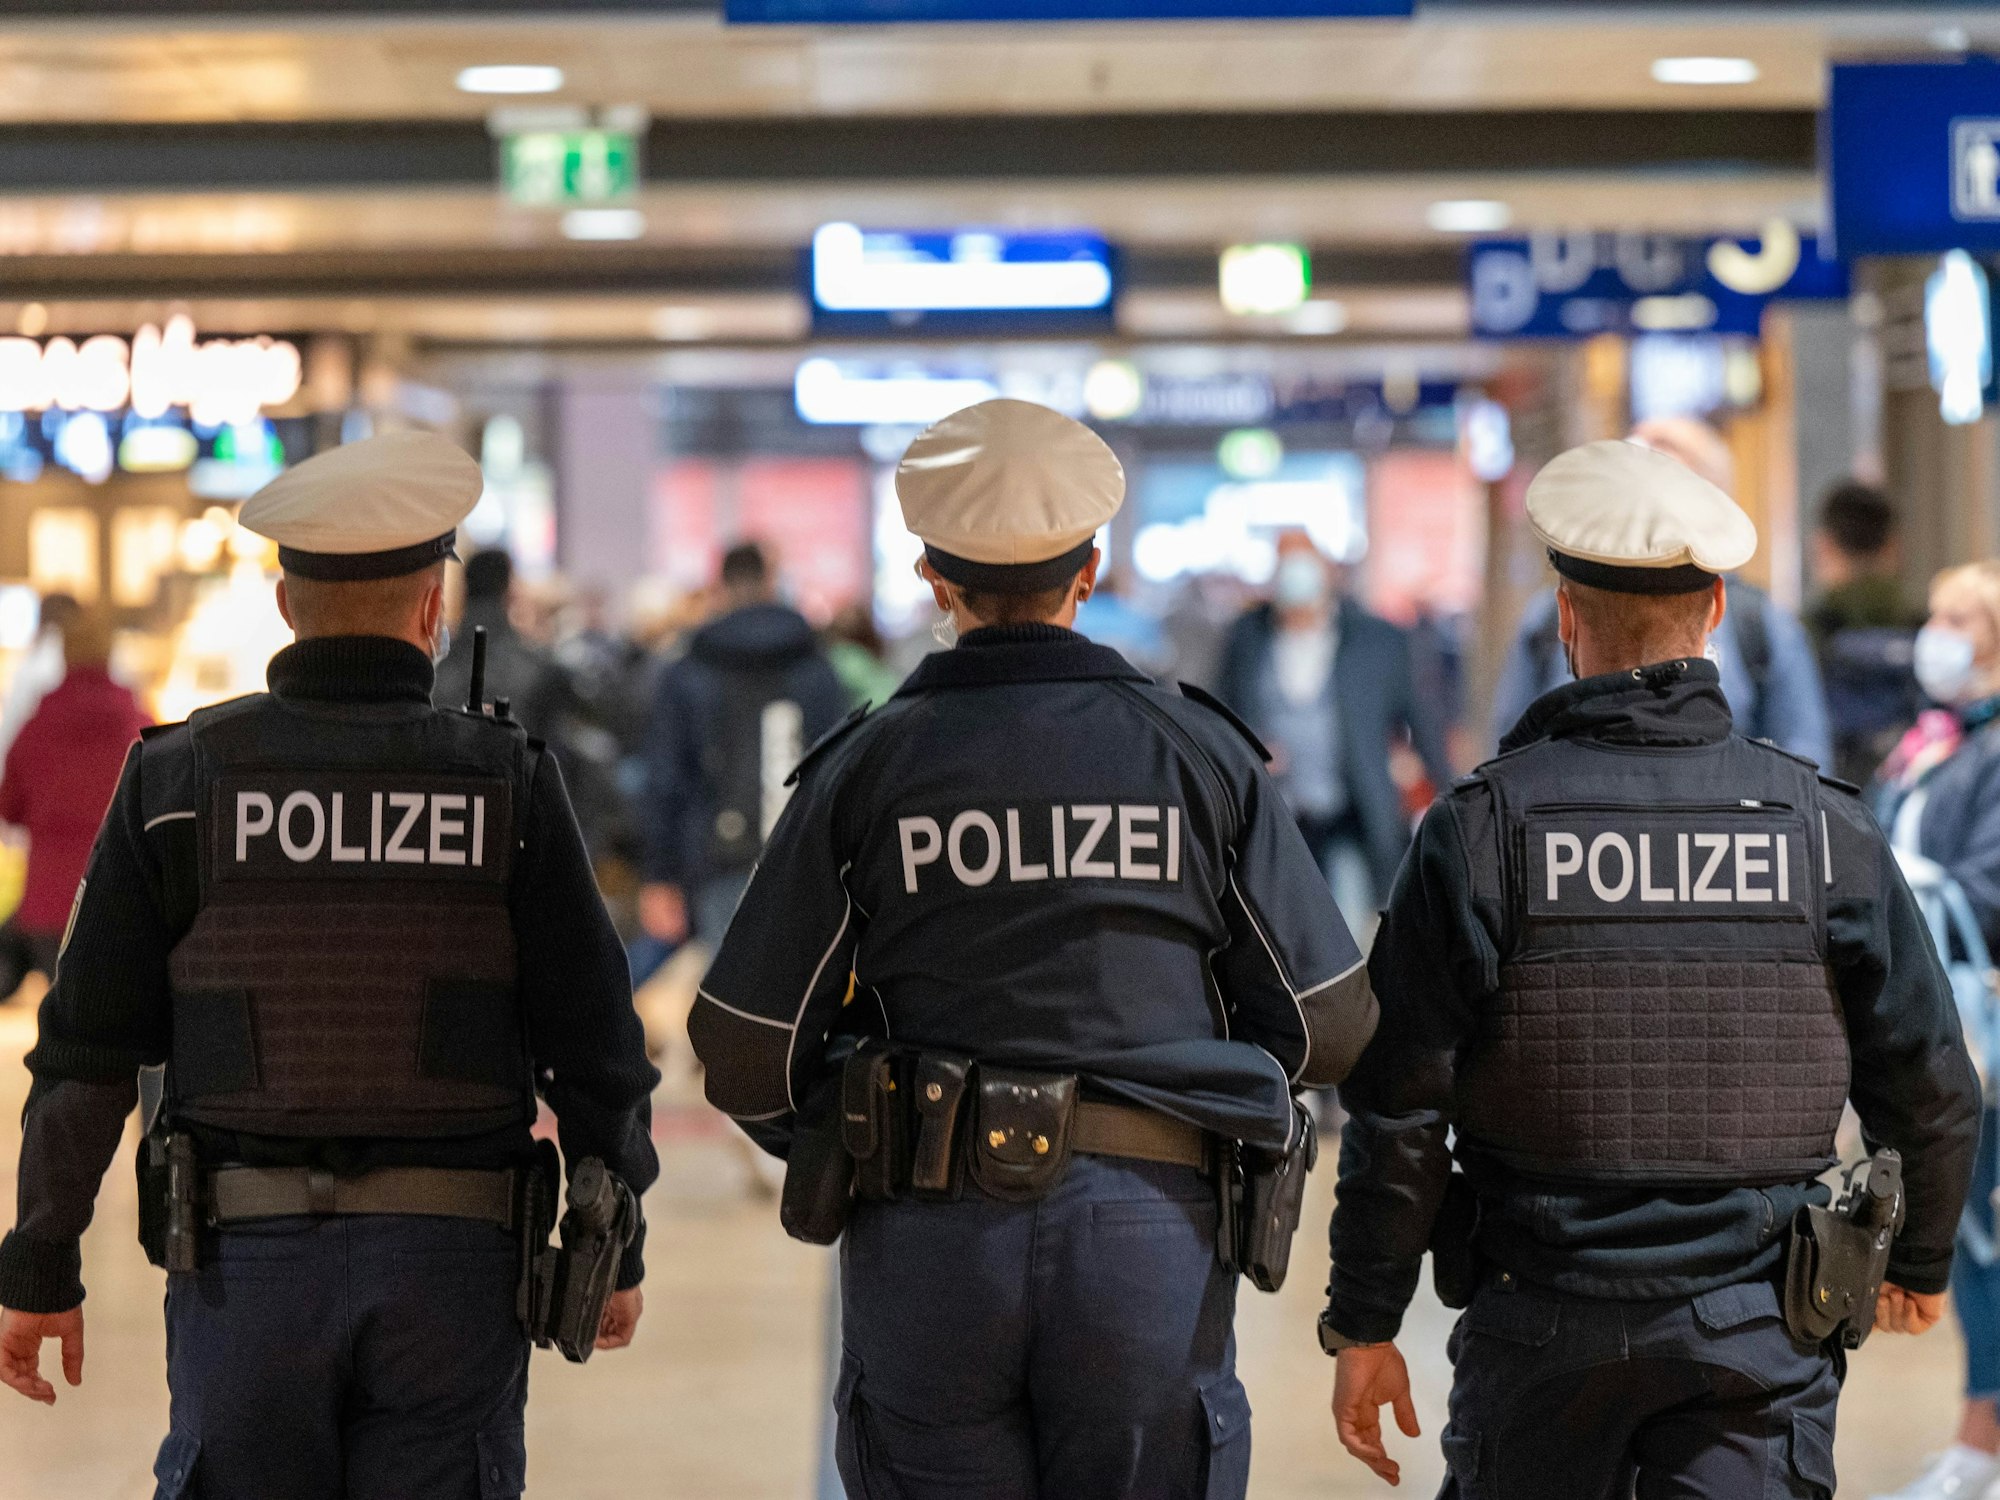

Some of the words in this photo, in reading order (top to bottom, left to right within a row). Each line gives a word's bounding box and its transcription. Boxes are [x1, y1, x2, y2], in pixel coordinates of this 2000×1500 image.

[235, 790, 485, 867] POLIZEI
[898, 804, 1180, 894] POLIZEI
[1545, 831, 1790, 903] POLIZEI
